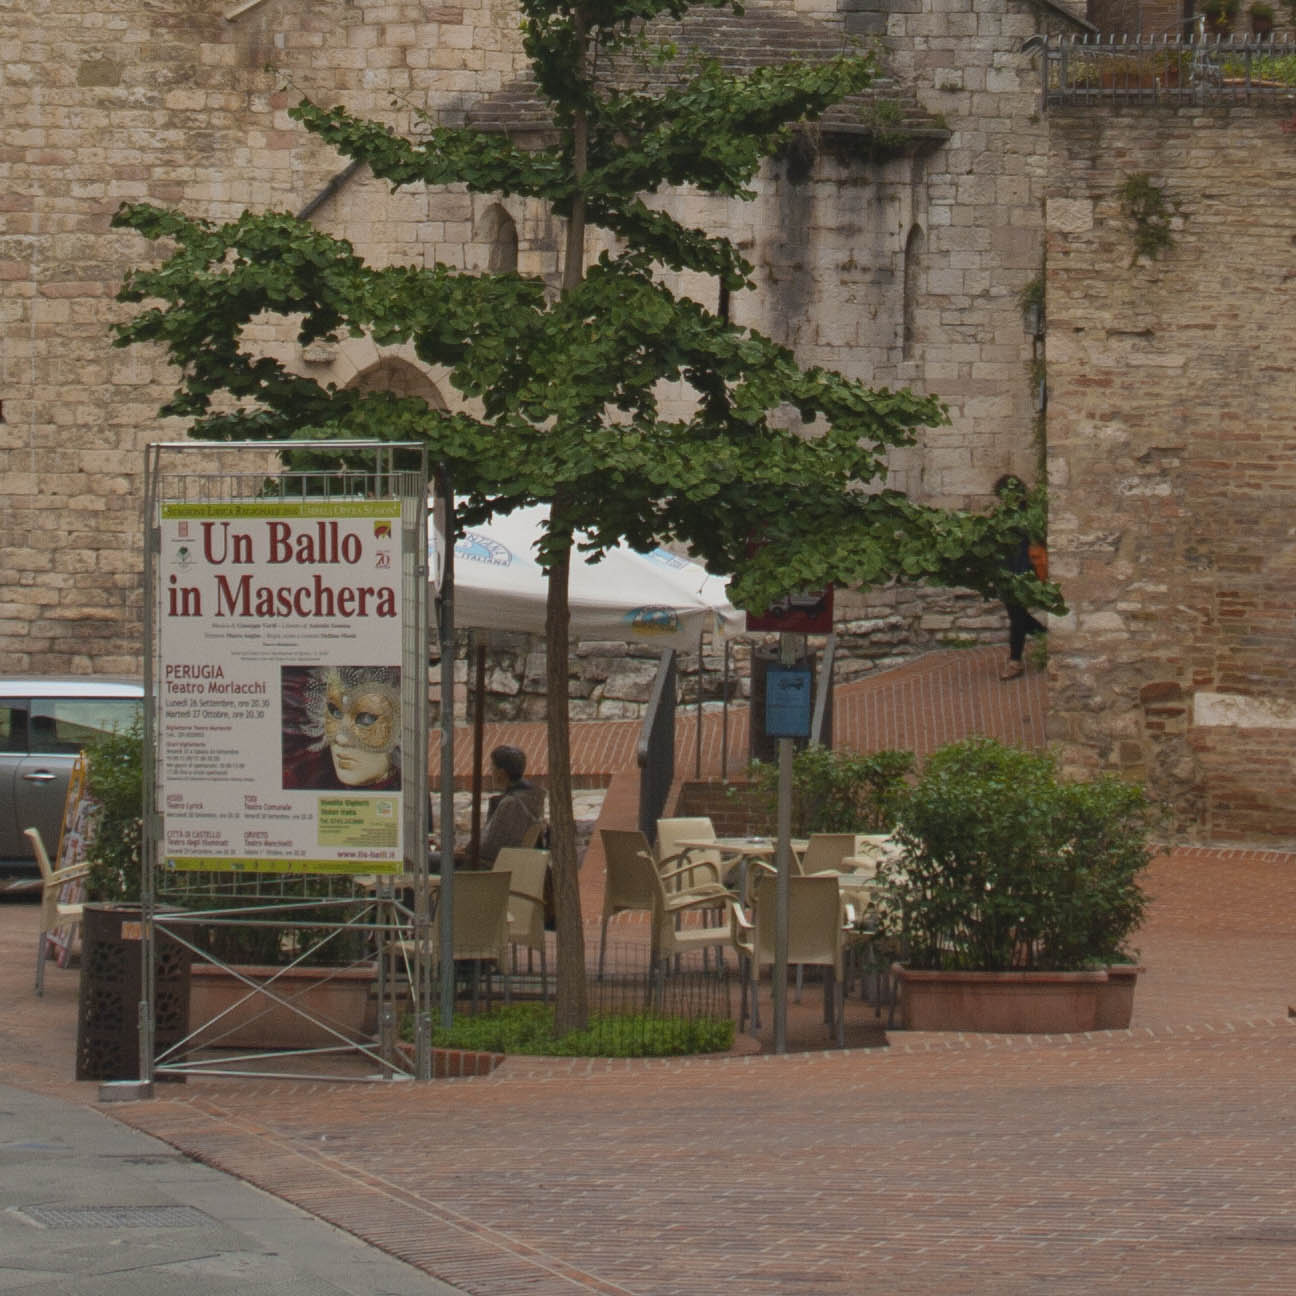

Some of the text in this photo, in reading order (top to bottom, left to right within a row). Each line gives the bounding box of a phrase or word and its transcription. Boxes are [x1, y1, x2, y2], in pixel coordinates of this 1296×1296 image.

[200, 521, 363, 565] Un Ballo
[168, 574, 398, 618] in Maschera
[165, 664, 225, 679] PERUGIA
[166, 681, 266, 694] Teatro Morlacchi
